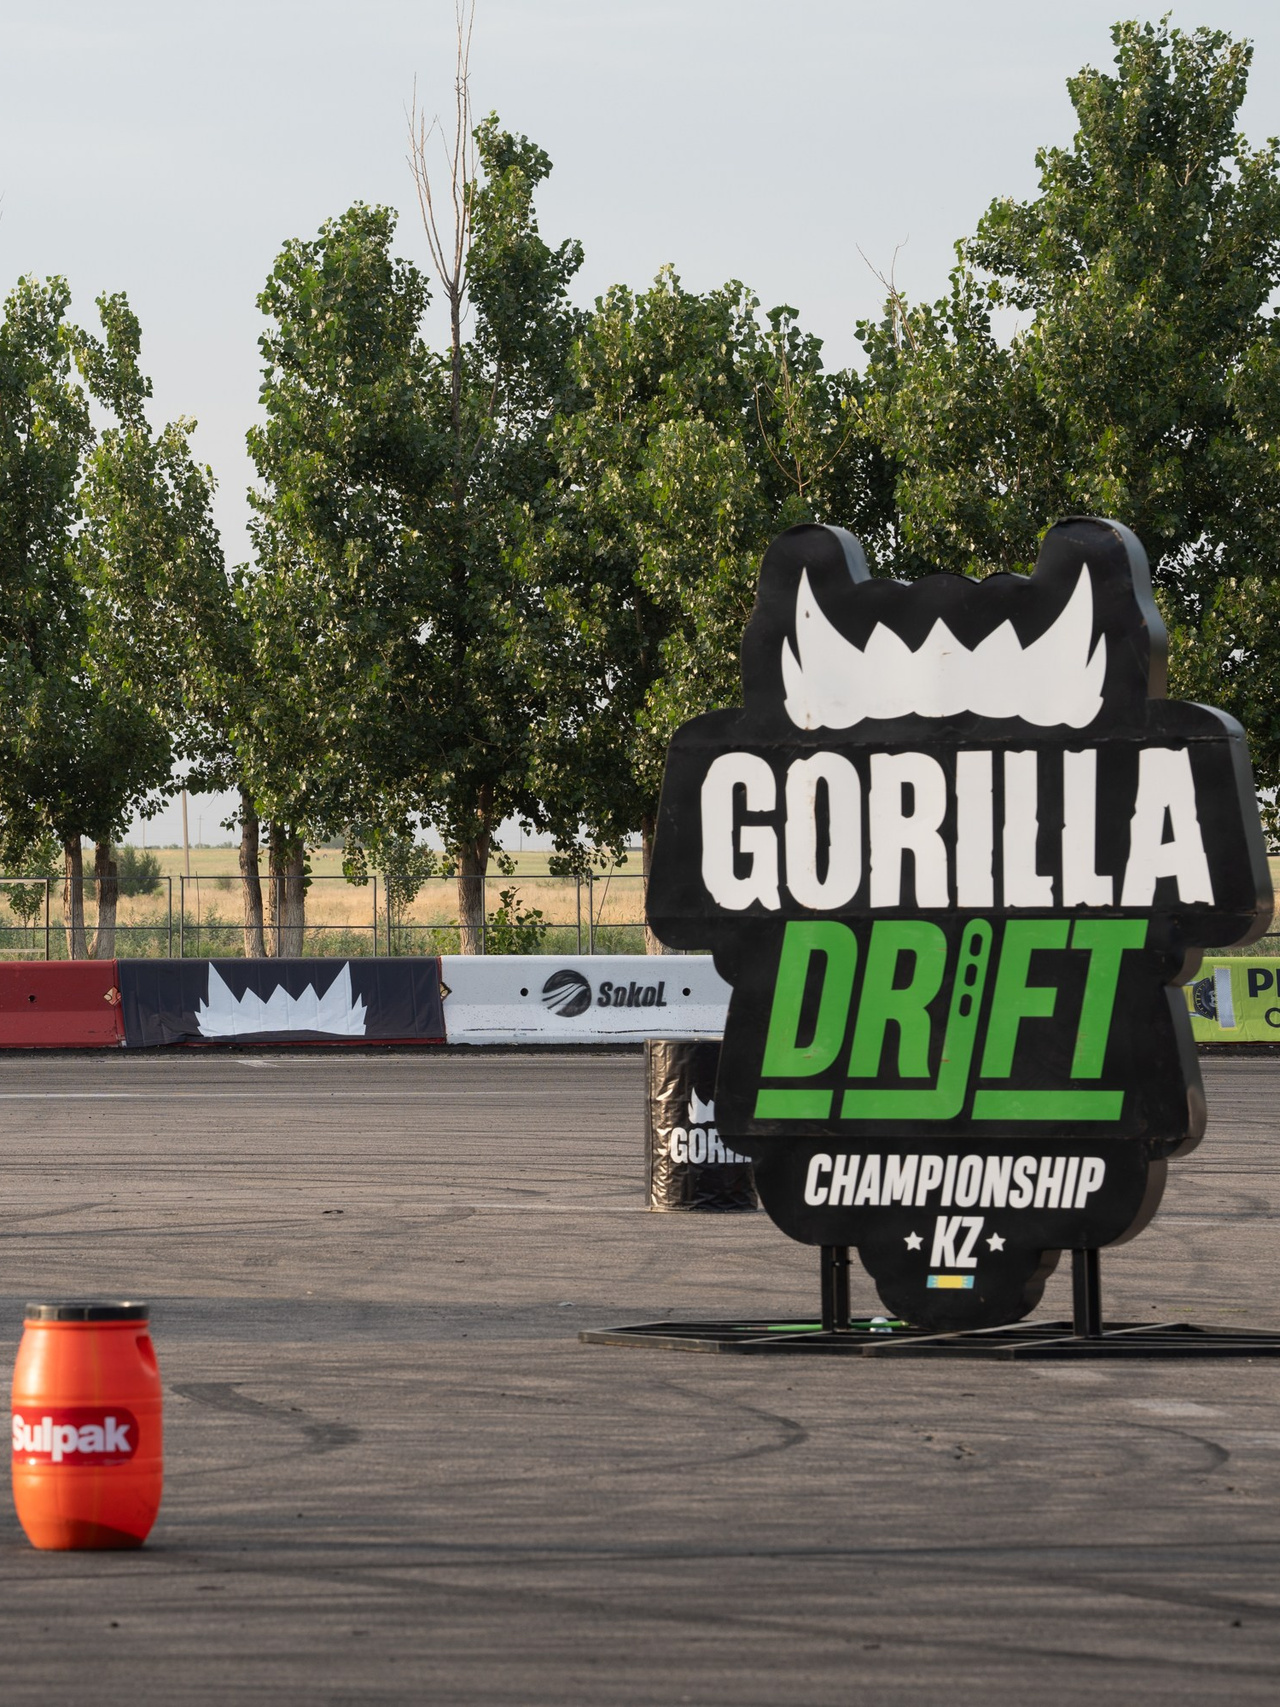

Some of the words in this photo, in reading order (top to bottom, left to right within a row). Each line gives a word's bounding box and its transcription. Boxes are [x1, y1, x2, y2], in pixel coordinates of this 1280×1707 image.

[700, 747, 1215, 911] GORILLA
[754, 918, 1149, 1120] DRIFT
[804, 1153, 1106, 1209] CHAMPIONSHIP
[929, 1215, 985, 1268] KZ
[12, 1413, 132, 1462] Sulpak
